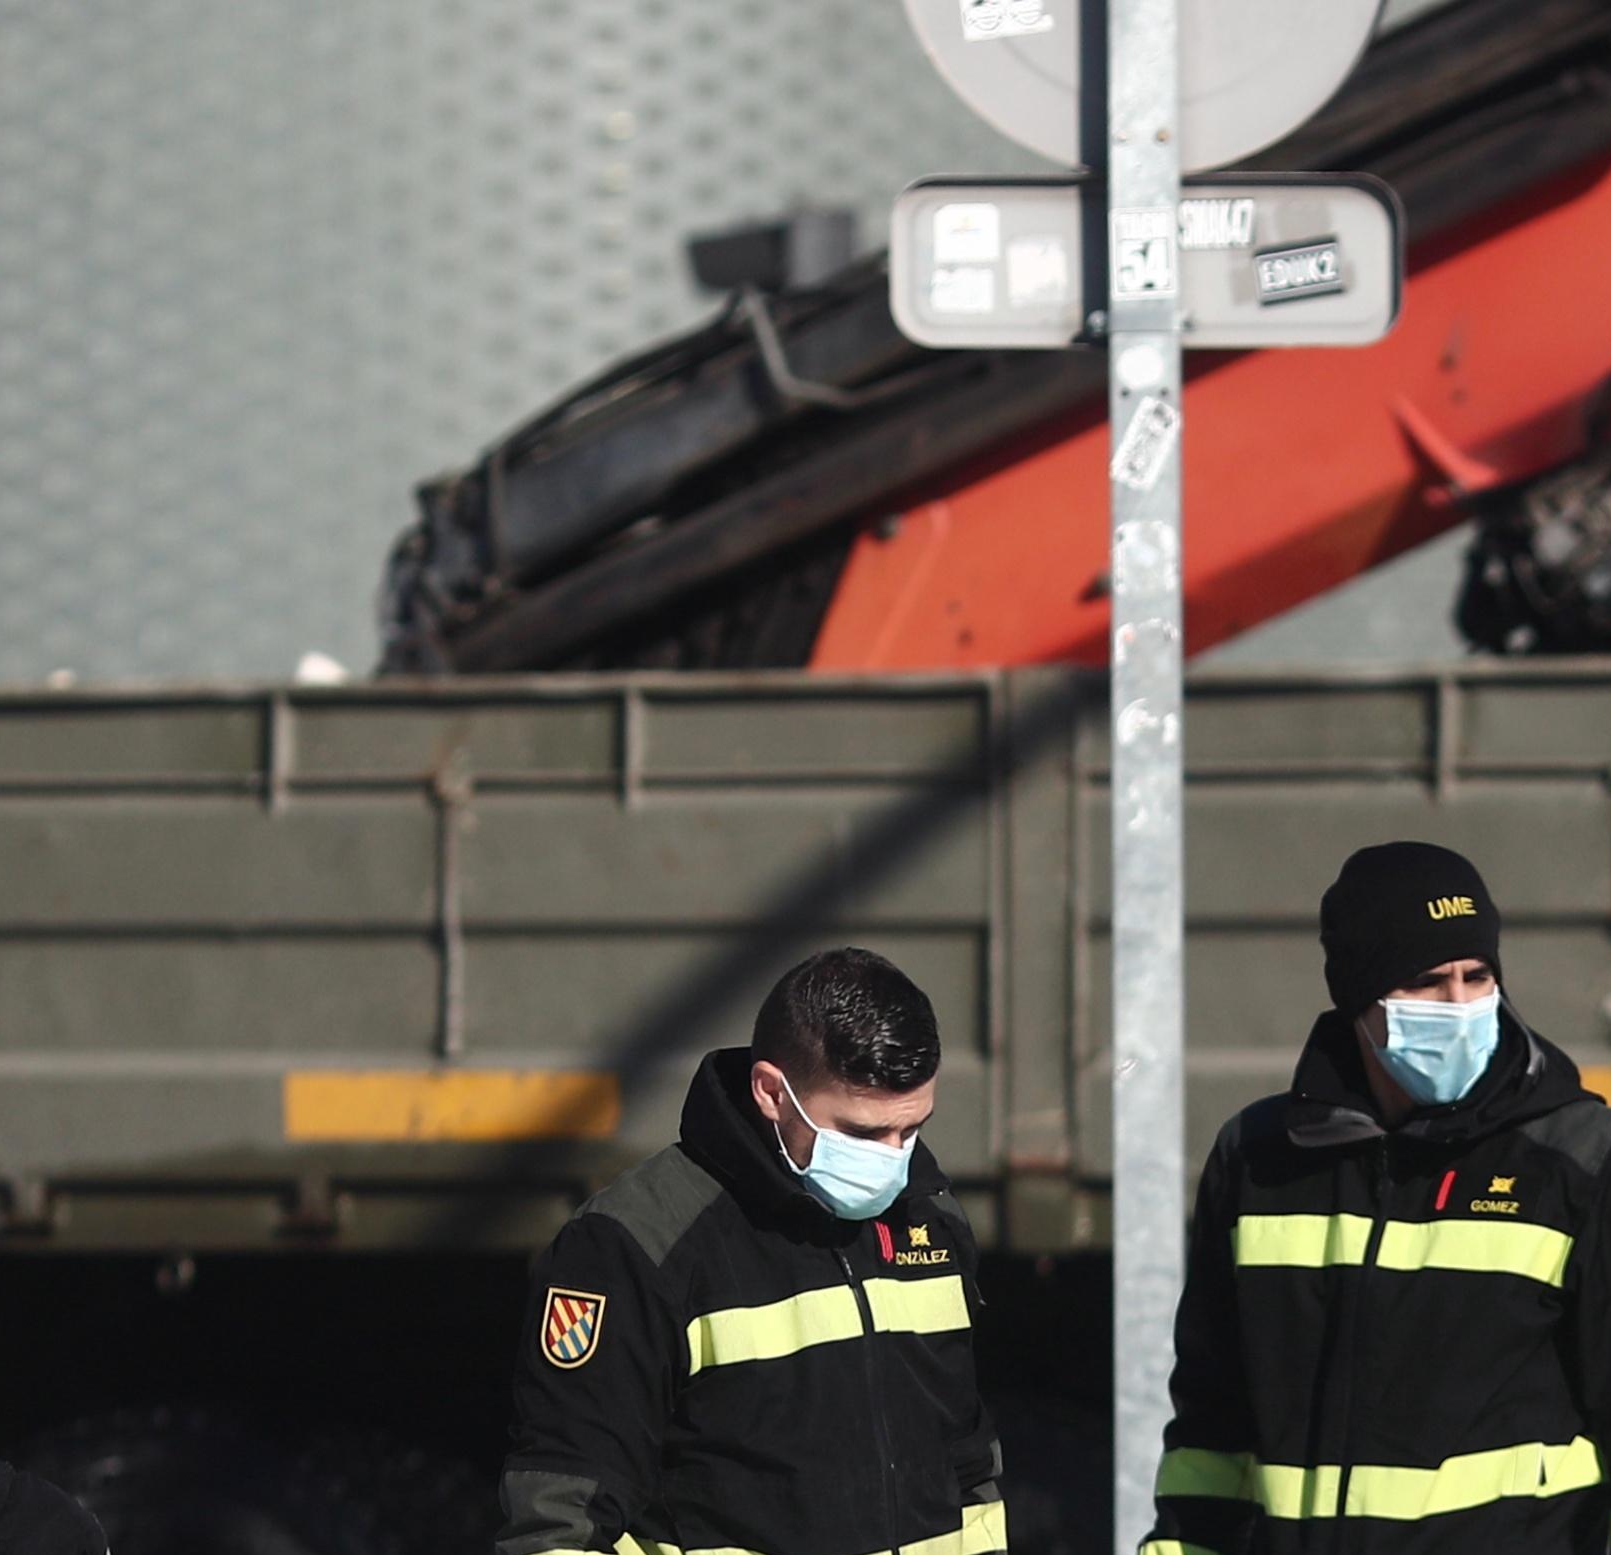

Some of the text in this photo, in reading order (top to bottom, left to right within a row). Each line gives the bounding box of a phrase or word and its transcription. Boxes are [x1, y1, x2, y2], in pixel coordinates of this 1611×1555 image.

[1120, 239, 1170, 289] 54
[1427, 896, 1478, 920] UME
[1470, 1199, 1520, 1215] GOMEZ
[895, 1248, 951, 1266] ONZÁLEZ
